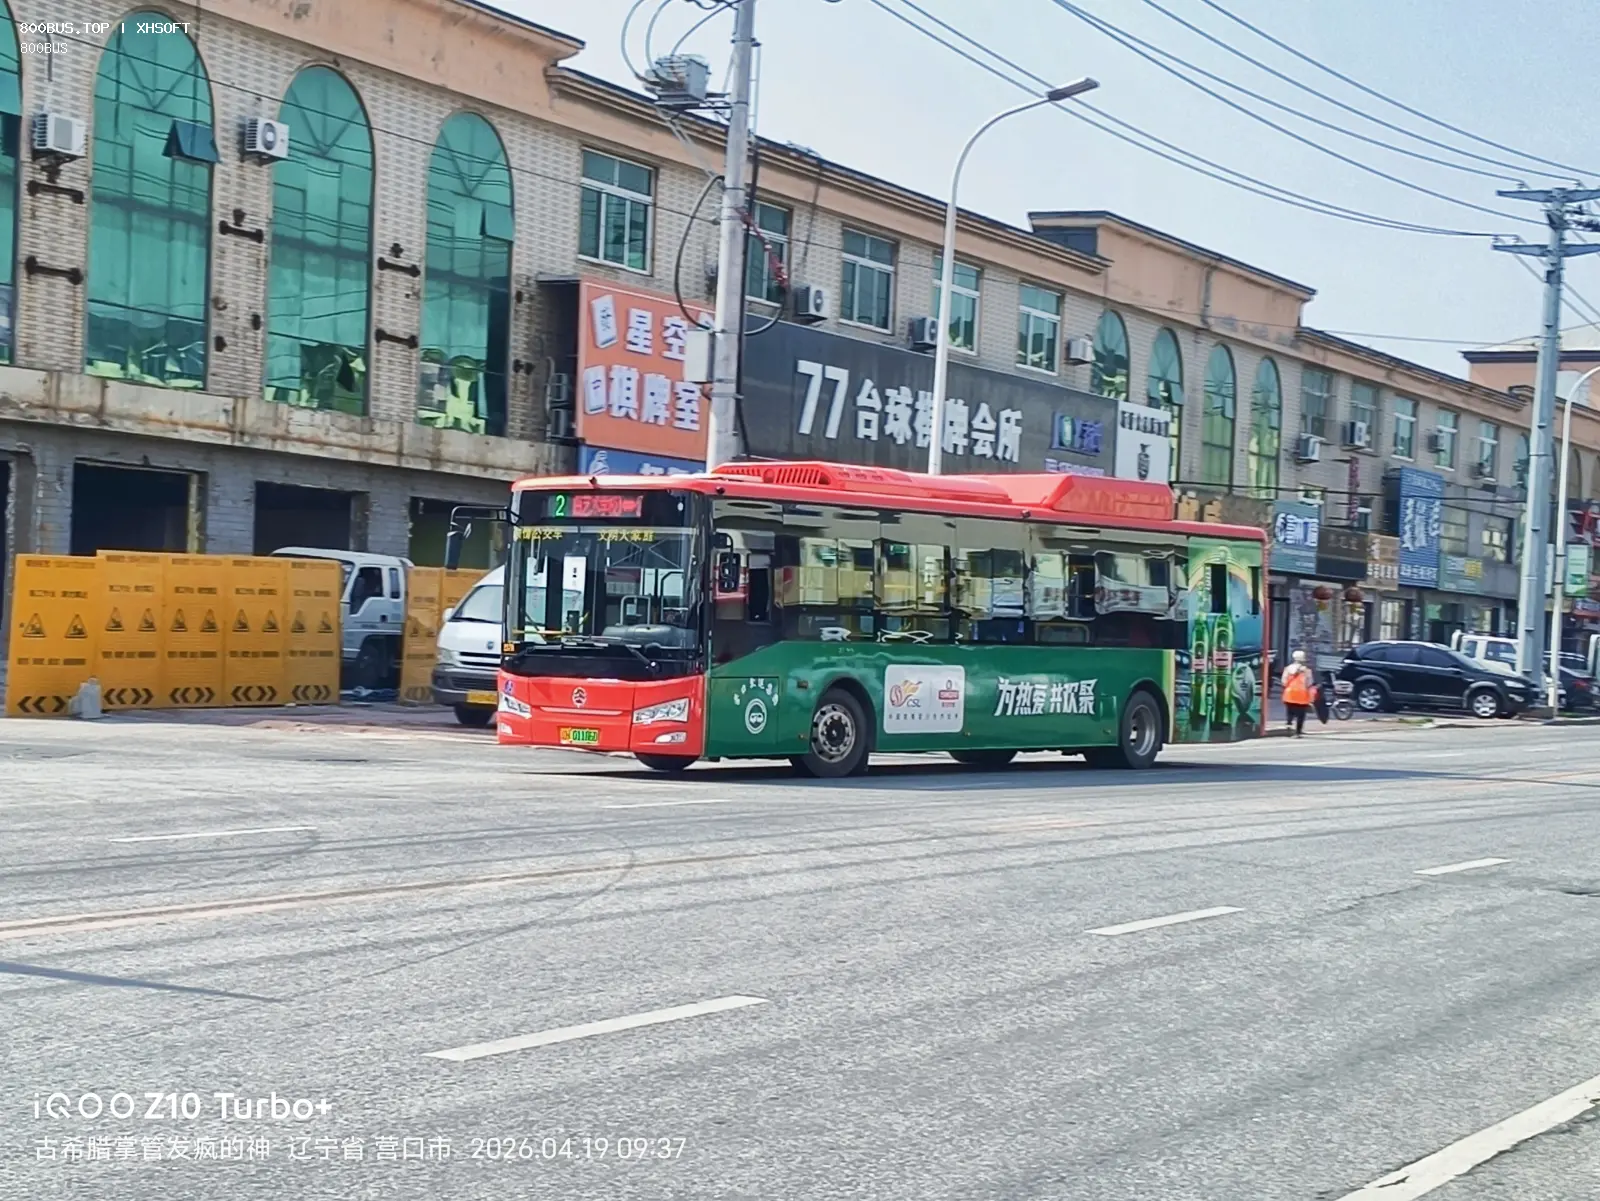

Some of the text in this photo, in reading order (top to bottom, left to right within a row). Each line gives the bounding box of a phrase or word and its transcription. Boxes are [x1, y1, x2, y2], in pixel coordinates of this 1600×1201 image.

[608, 364, 701, 431] 棋牌室
[555, 495, 566, 517] 2
